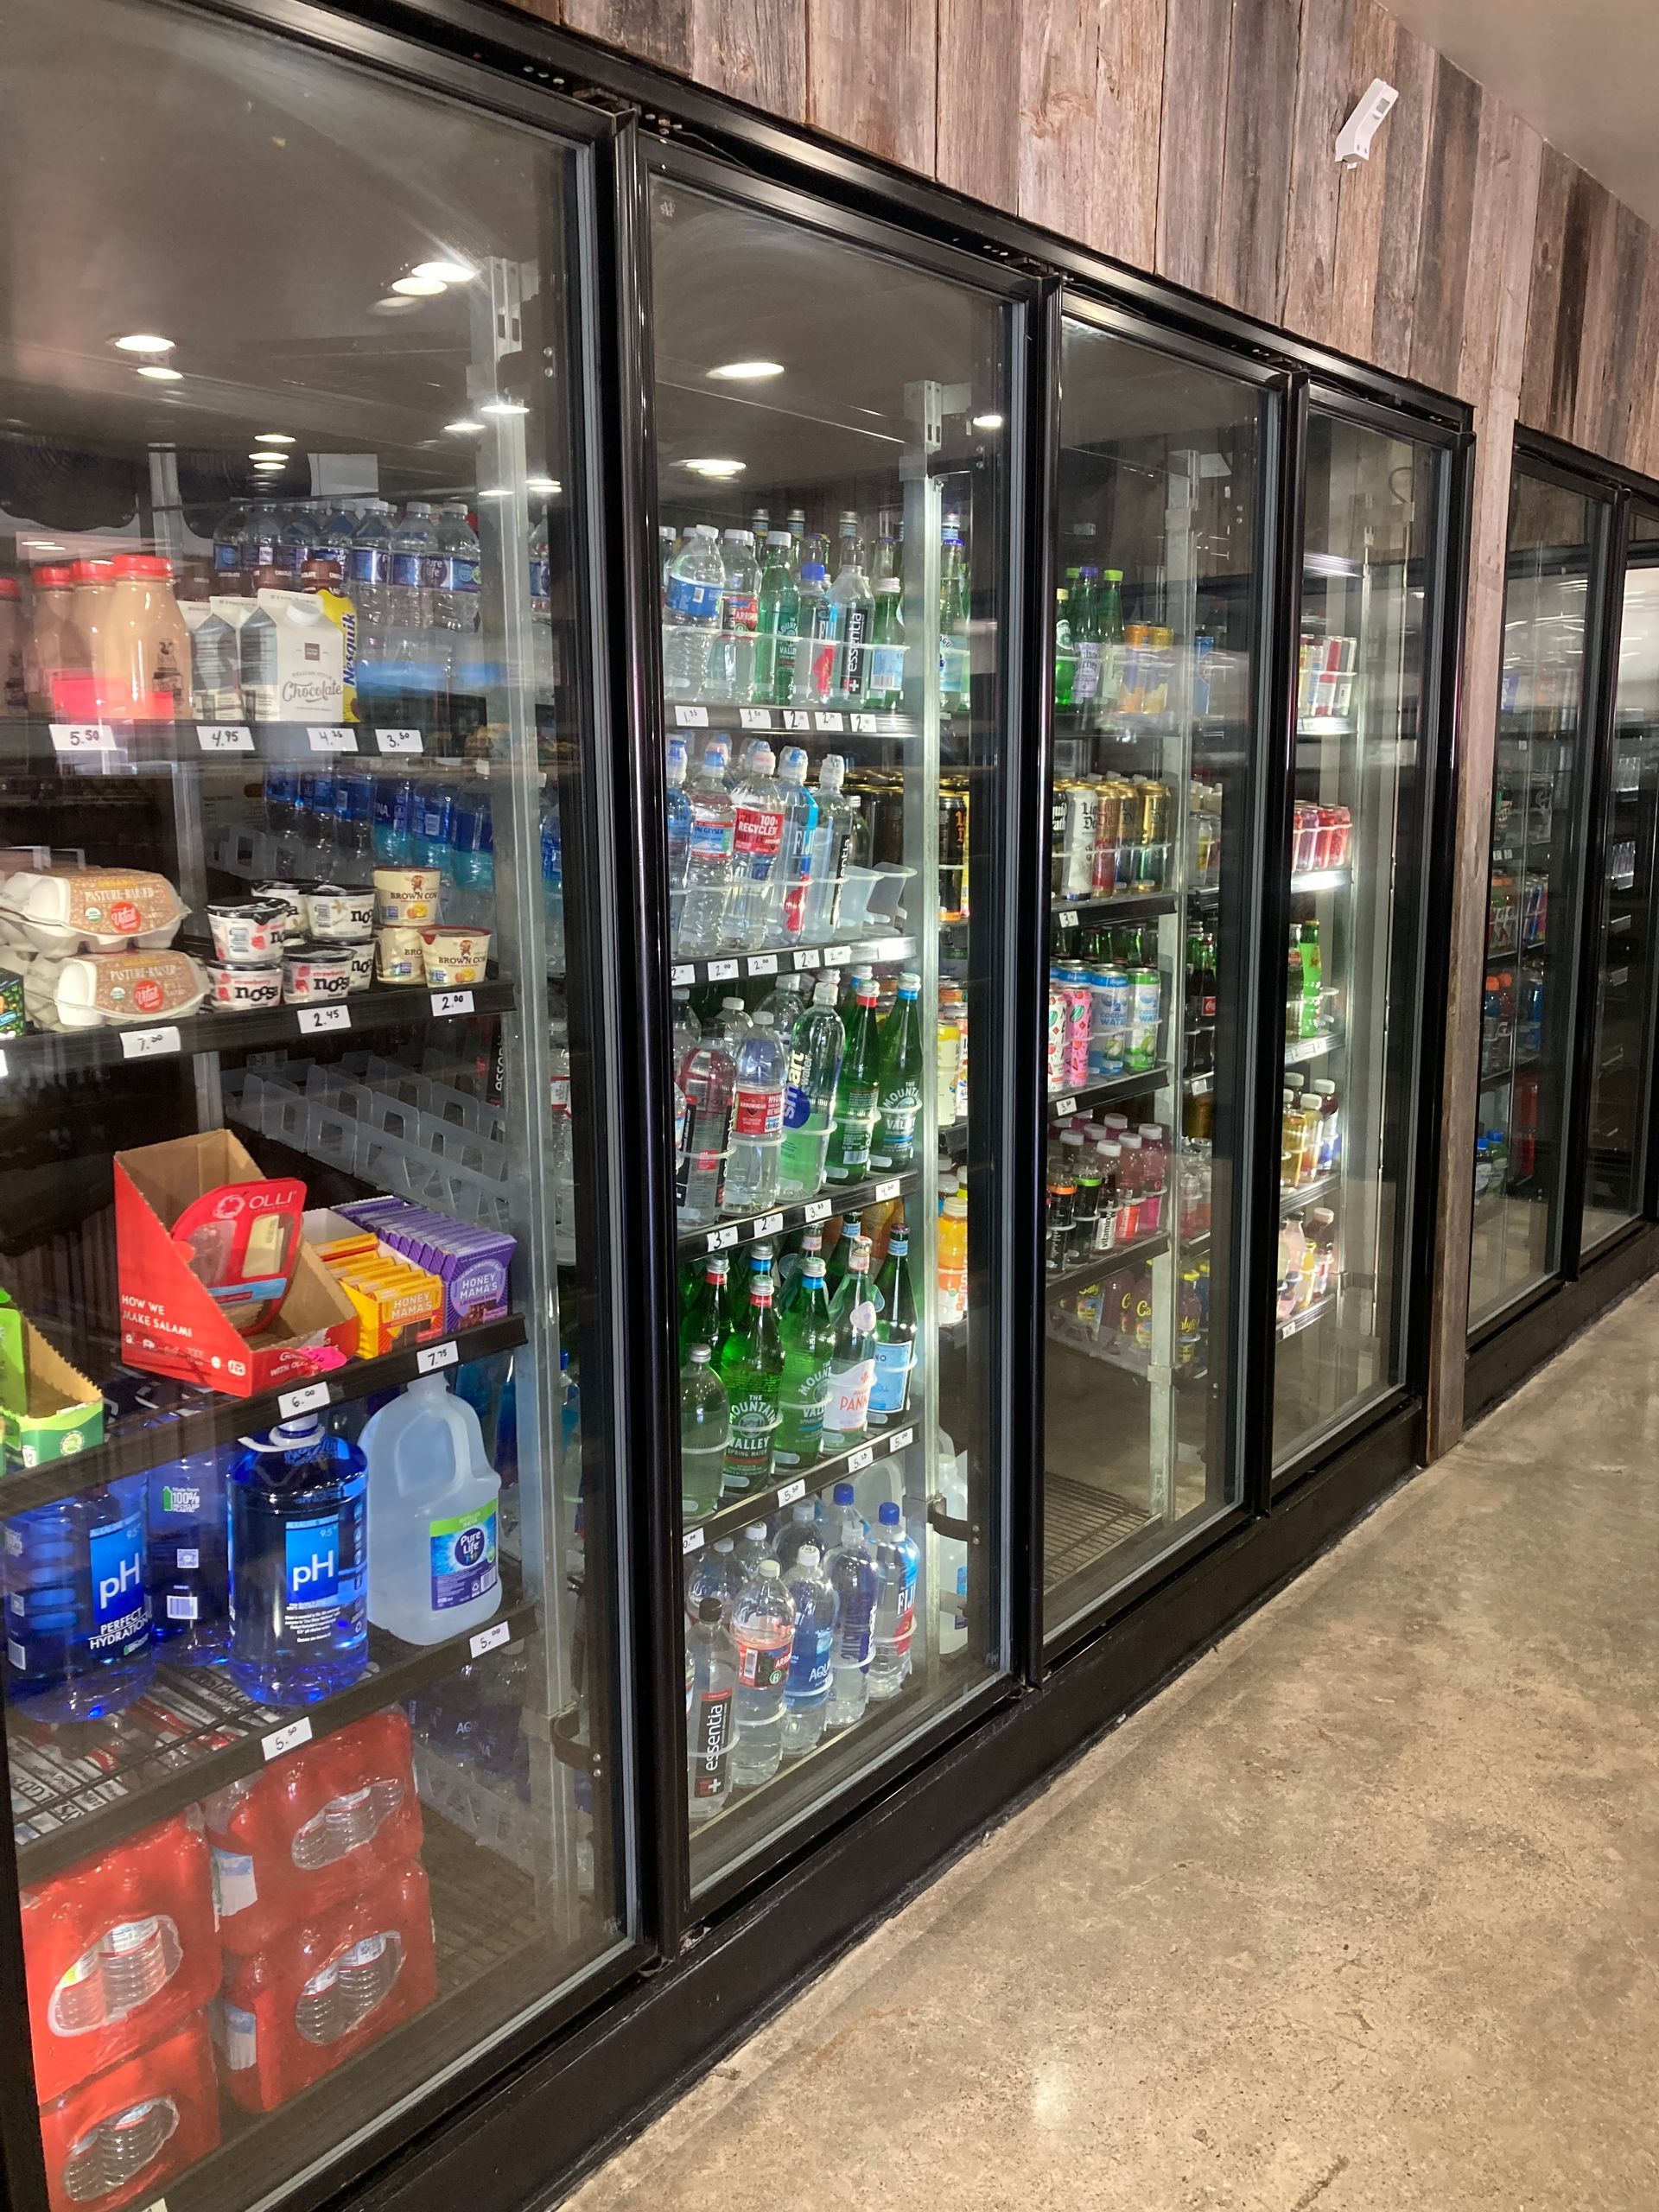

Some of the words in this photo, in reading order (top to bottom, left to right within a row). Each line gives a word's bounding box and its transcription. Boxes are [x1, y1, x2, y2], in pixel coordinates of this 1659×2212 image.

[342, 613, 356, 686] Nesquik
[283, 679, 343, 702] Chocolate
[69, 728, 100, 747] 5.50
[211, 730, 239, 747] 4.95
[386, 732, 410, 748] 3.50
[738, 821, 778, 836] RECYCLED
[792, 830, 814, 855] FIJI
[85, 887, 156, 903] PASTURE-RAISED
[439, 957, 473, 965] BROWN
[110, 964, 177, 982] PASTURE-RAISED
[314, 976, 350, 992] noos
[442, 995, 464, 1011] 2.00
[313, 1009, 340, 1027] 2.45
[784, 1049, 805, 1120] smart
[249, 1192, 293, 1209] OLLI
[461, 1272, 497, 1290] HONEY
[460, 1282, 499, 1300] MAMA'S
[122, 1294, 146, 1310] HOW
[149, 1301, 165, 1316] WE
[394, 1292, 431, 1309] HONEY
[391, 1301, 433, 1319] MAMA'S
[122, 1310, 151, 1327] MAKE
[153, 1319, 193, 1338] SALAMI
[428, 1349, 448, 1367] 7.75
[291, 1389, 316, 1408] 6.00
[728, 1401, 777, 1425] MOUNTAIN
[728, 1435, 771, 1450] VALLEY
[172, 1491, 200, 1504] 100%
[461, 1530, 482, 1547] Pure
[462, 1541, 480, 1555] Life
[292, 1550, 334, 1592] pH
[99, 1552, 141, 1610] pH
[100, 1606, 143, 1634] PERFECT
[89, 1613, 152, 1651] HYDRATION
[480, 1628, 501, 1649] 5.00
[276, 1726, 298, 1751] 5.50
[705, 1703, 724, 1772] essentia
